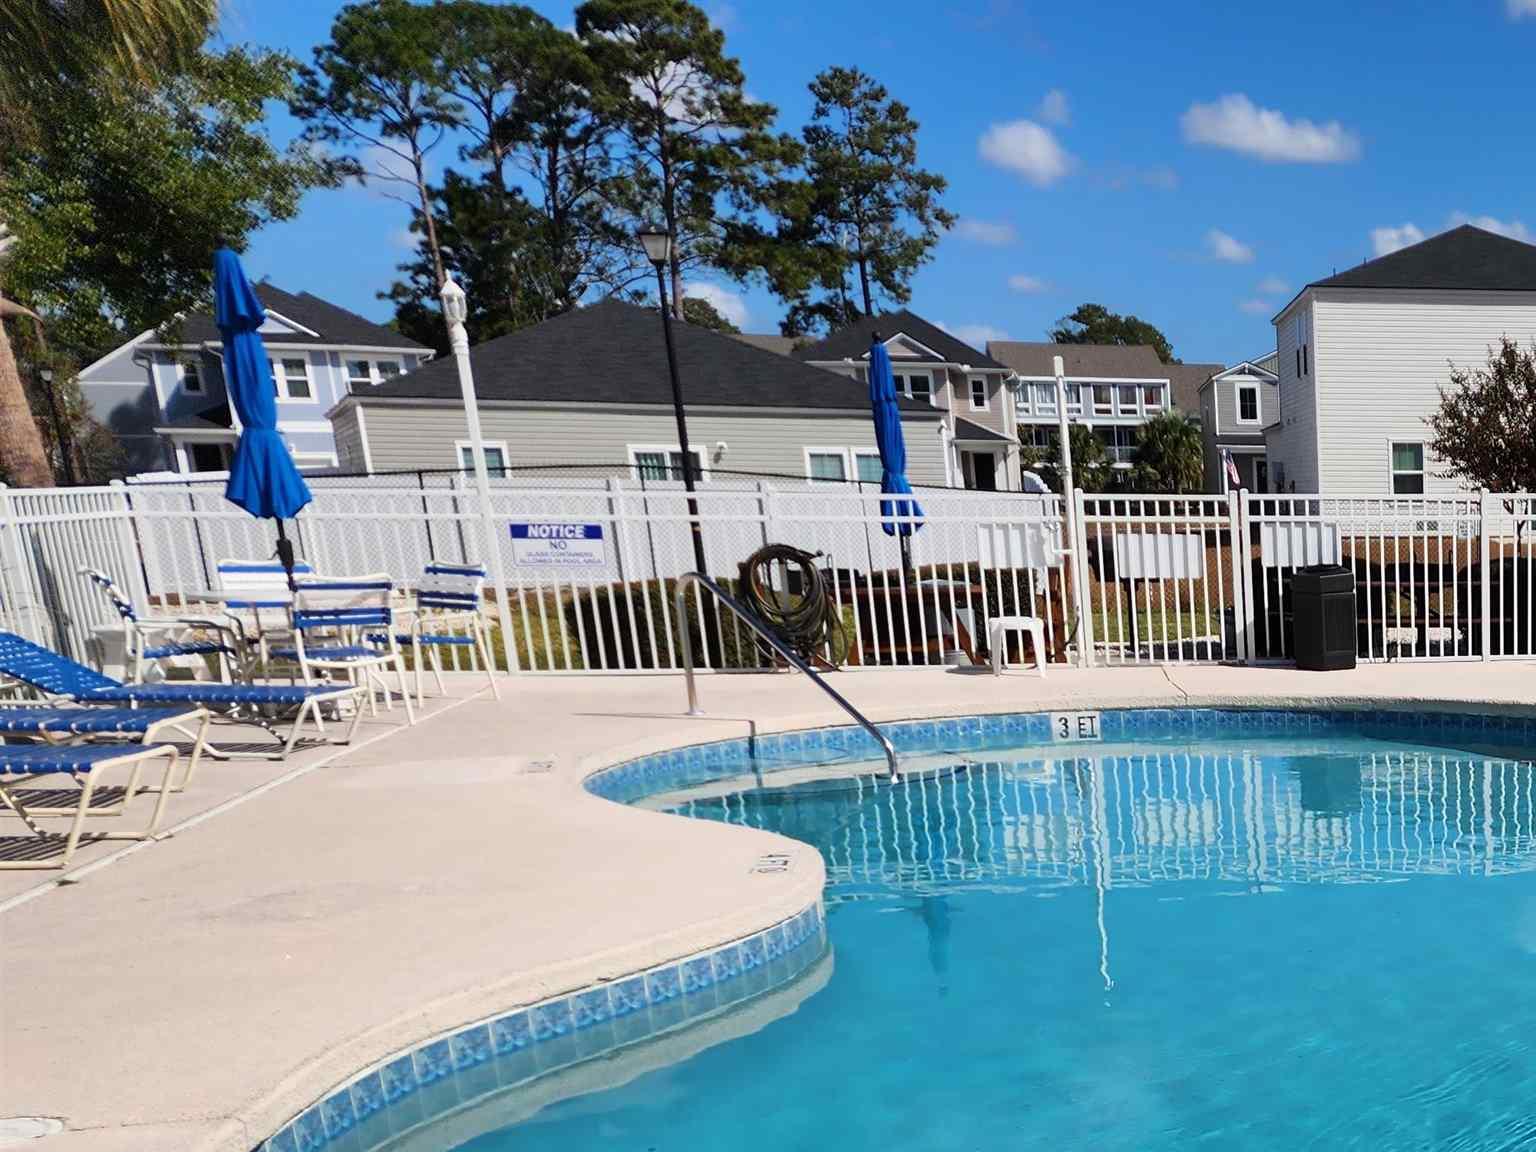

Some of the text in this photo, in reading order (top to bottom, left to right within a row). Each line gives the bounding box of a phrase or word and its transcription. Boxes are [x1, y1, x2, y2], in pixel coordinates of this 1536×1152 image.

[527, 524, 585, 538] NOTICE
[549, 541, 568, 550] NO
[1058, 716, 1070, 739] 3
